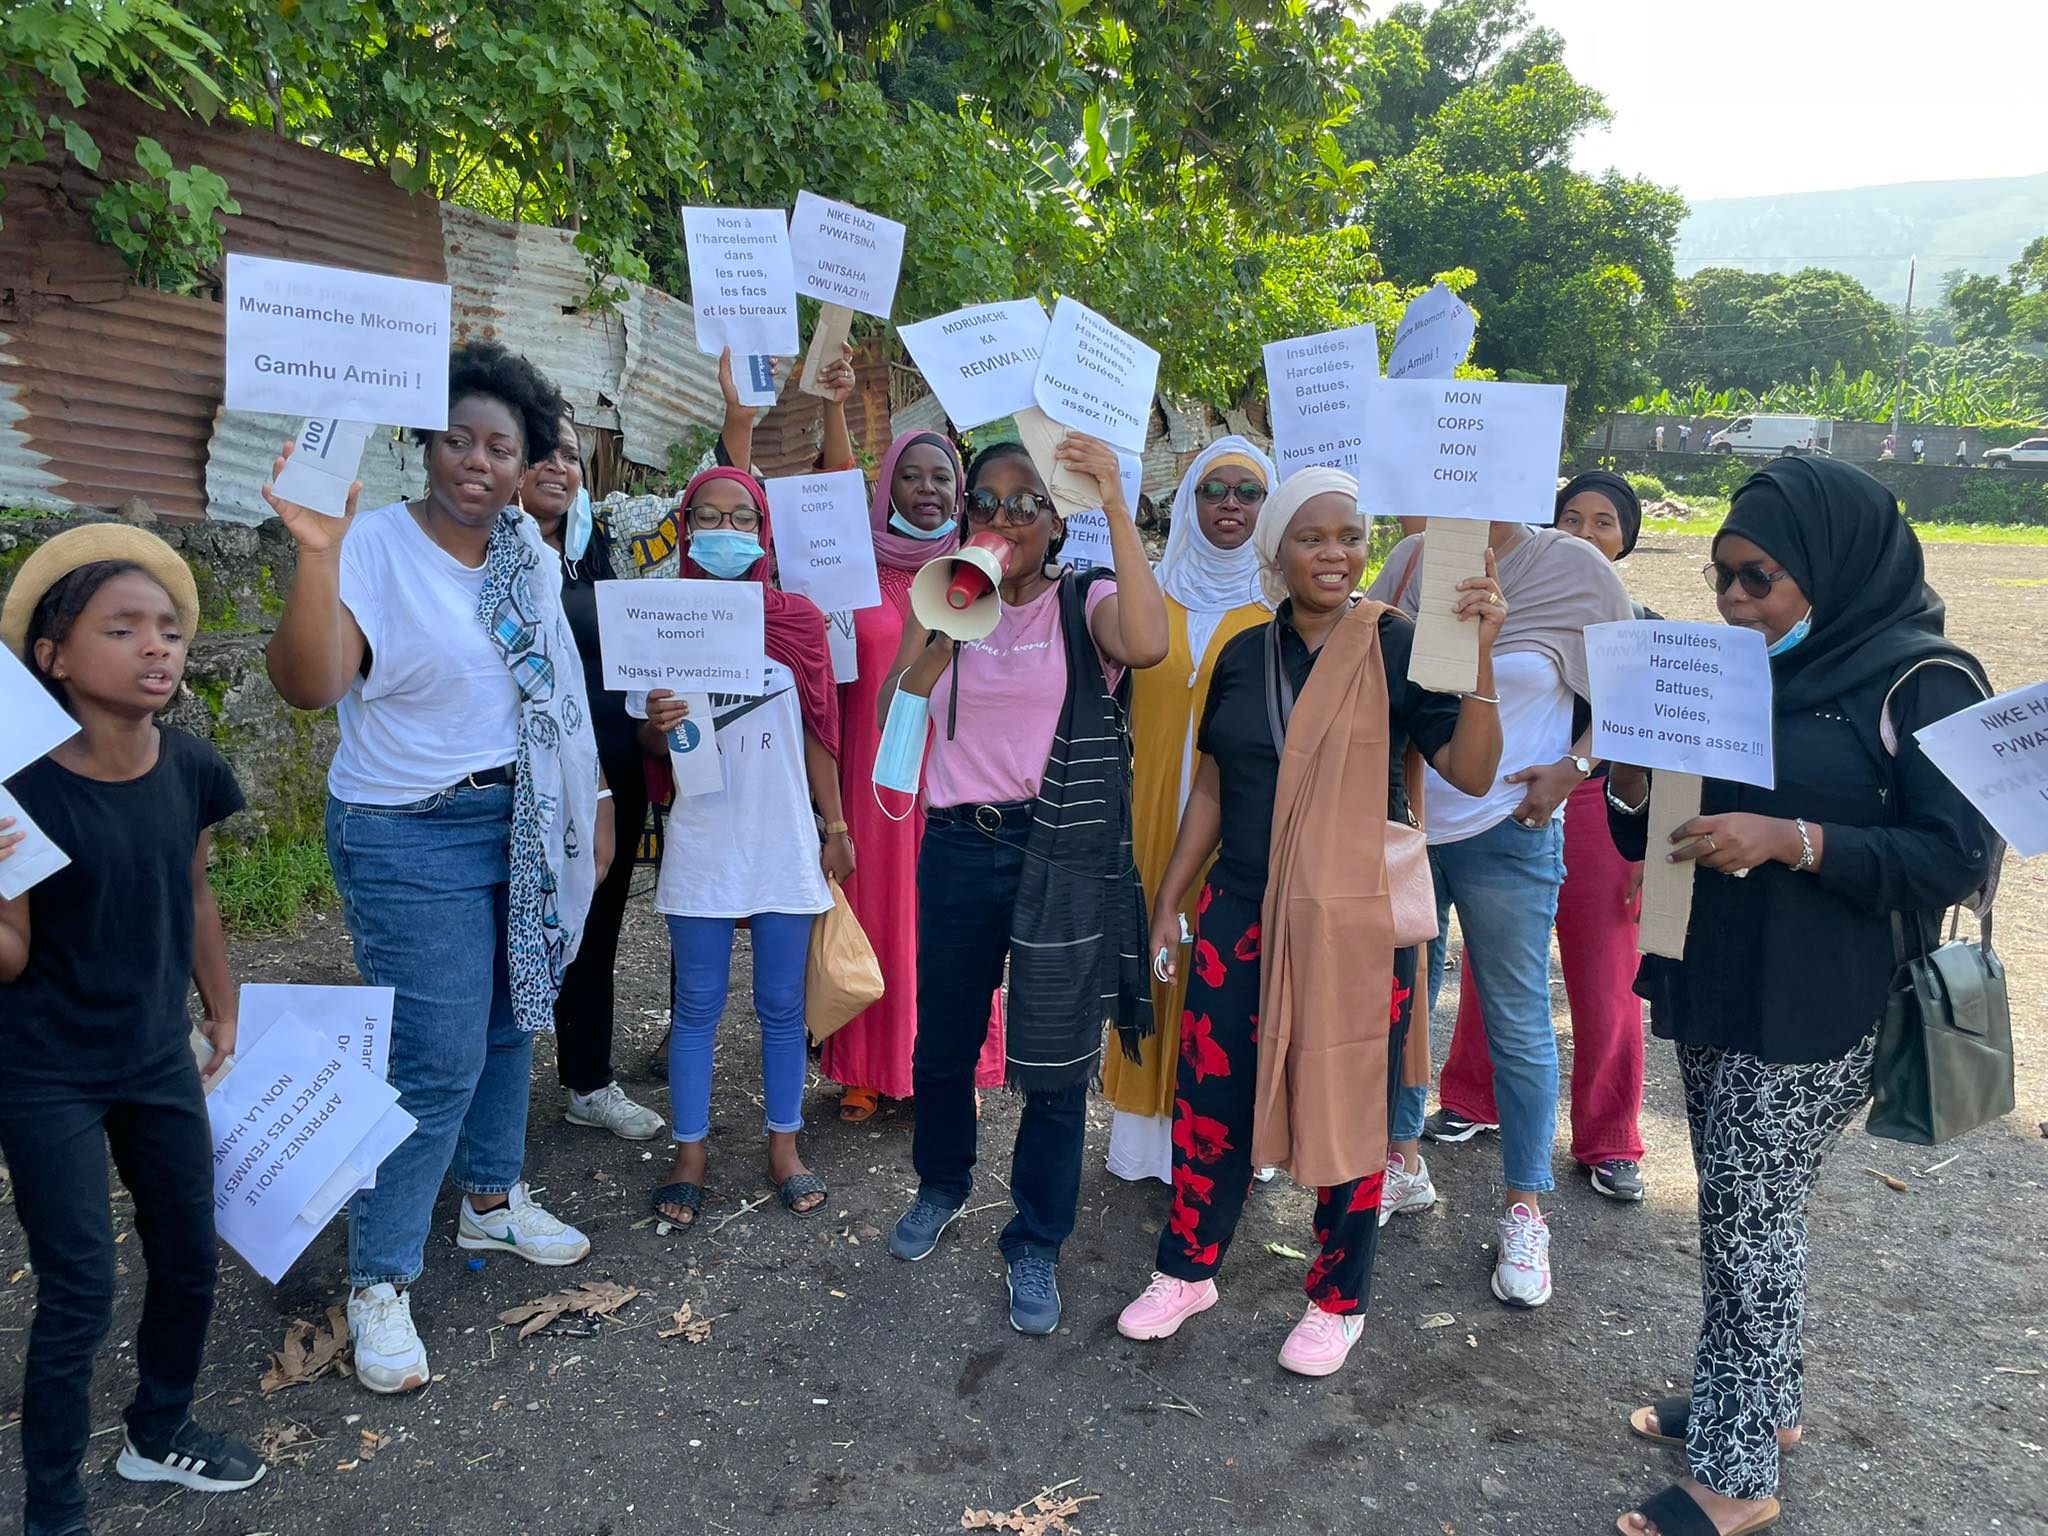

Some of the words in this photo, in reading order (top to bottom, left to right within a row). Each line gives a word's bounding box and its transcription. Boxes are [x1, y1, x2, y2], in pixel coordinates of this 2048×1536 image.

[716, 217, 741, 229] Non
[745, 217, 752, 229] à
[826, 207, 851, 224] NIKE
[852, 215, 875, 232] HAZI
[696, 233, 777, 244] l'harcelement
[819, 224, 876, 250] PVWATSINA
[724, 249, 754, 260] dans
[715, 268, 733, 279] les
[736, 269, 768, 280] rues,
[818, 259, 867, 283] UNITSAHA
[720, 285, 738, 296] les
[741, 285, 767, 296] facs
[807, 275, 831, 290] OWU
[833, 282, 858, 299] WAZI
[859, 289, 870, 302] !!!
[239, 296, 355, 325] Mwanamche
[360, 312, 437, 336] Mkomori
[703, 306, 715, 317] et
[718, 305, 736, 316] les
[739, 304, 788, 316] bureaux
[942, 310, 1008, 335] MDRUMCHE
[1081, 312, 1136, 354] Insultées,
[980, 333, 997, 346] KA
[1075, 324, 1136, 368] Harcelées,
[1286, 339, 1350, 360] Insultées,
[959, 350, 1024, 379] REMWA
[1023, 346, 1041, 362] !!!
[1078, 340, 1128, 376] Battues,
[254, 354, 336, 380] Gamhu
[343, 364, 408, 389] Amini
[415, 372, 421, 390] !
[1076, 354, 1125, 387] Violées,
[1286, 358, 1355, 380] Harcelées,
[1295, 379, 1350, 398] Battues,
[1444, 390, 1482, 405] MON
[1044, 373, 1079, 396] Nous
[1082, 389, 1098, 404] en
[1101, 399, 1139, 426] avons
[1298, 399, 1351, 417] Violées,
[1061, 397, 1100, 420] assez
[1103, 413, 1118, 429] !!!
[1437, 416, 1485, 431] CORPS
[302, 420, 324, 453] 100
[1283, 445, 1315, 460] Nous
[1318, 442, 1334, 453] en
[1338, 437, 1361, 449] avo
[1439, 442, 1477, 457] MON
[1344, 453, 1358, 466] !!!
[1433, 467, 1478, 483] CHOIX
[801, 482, 828, 494] MON
[801, 501, 834, 513] CORPS
[810, 537, 836, 549] MON
[810, 556, 842, 568] CHOIX
[626, 607, 709, 622] Wanawache
[711, 609, 734, 622] Wa
[656, 627, 705, 640] komori
[1652, 630, 1721, 651] Insultées,
[617, 665, 662, 680] Ngassi
[666, 666, 742, 679] Pvwadzima
[745, 668, 749, 680] !
[1649, 655, 1723, 676] Harcelées,
[1655, 679, 1713, 700] Battues,
[1654, 703, 1711, 725] Violées,
[1979, 706, 2028, 732] NIKE
[675, 723, 690, 750] LARGE
[1601, 720, 1635, 736] Nous
[1638, 727, 1653, 739] en
[1657, 731, 1701, 746] avons
[1705, 736, 1749, 753] assez
[1751, 741, 1764, 757] !!!
[364, 1016, 378, 1031] Je
[361, 1034, 375, 1073] marc
[261, 1074, 293, 1106] NON
[292, 1059, 342, 1114] RESPECT
[243, 1105, 265, 1122] LA
[267, 1113, 294, 1140] DES
[212, 1123, 248, 1166] HAINE
[256, 1093, 342, 1191] APPRENEZ-MOI
[224, 1139, 270, 1194] FEMMES
[244, 1190, 261, 1207] LE
